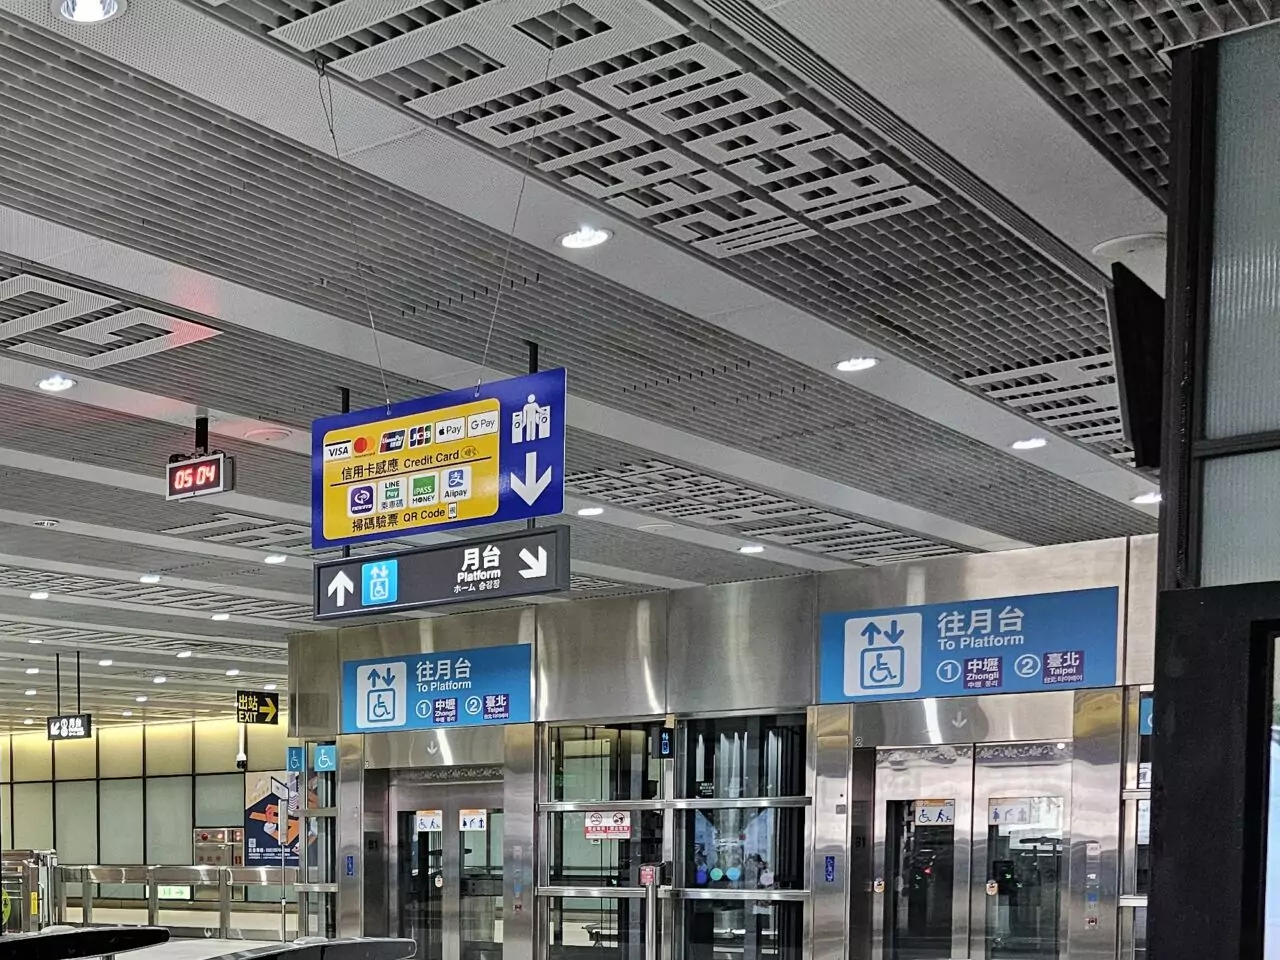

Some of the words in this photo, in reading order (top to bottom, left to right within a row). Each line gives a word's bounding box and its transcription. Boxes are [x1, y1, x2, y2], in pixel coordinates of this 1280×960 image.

[328, 446, 349, 457] VISA
[410, 430, 431, 442] JCB
[446, 424, 462, 437] Pay
[480, 418, 495, 430] Pay
[341, 458, 399, 481] 信用卡感應
[403, 454, 433, 469] Credit
[436, 450, 460, 463] Card
[175, 467, 193, 489] 05
[196, 465, 216, 485] 04
[385, 481, 400, 489] LINE
[412, 495, 435, 504] MONEY
[444, 489, 468, 499] Alipay
[352, 513, 399, 533] 掃碼驗票
[403, 512, 418, 522] QR
[420, 508, 445, 520] Code
[461, 545, 501, 571] 月台
[457, 570, 501, 583] Platform
[453, 583, 476, 593] ホーム
[937, 605, 1024, 637] 往月台
[938, 638, 956, 651] To
[960, 635, 1024, 649] Platform
[967, 658, 999, 673] 中壢
[1047, 652, 1080, 668] 臺北
[416, 657, 471, 682] 往月台
[966, 672, 999, 681] Zhongli
[1050, 667, 1076, 676] Taipei
[416, 683, 428, 692] To
[430, 680, 471, 692] Platform
[239, 694, 258, 711] 出站
[435, 698, 456, 711] 中壢
[239, 711, 258, 722] EXIT
